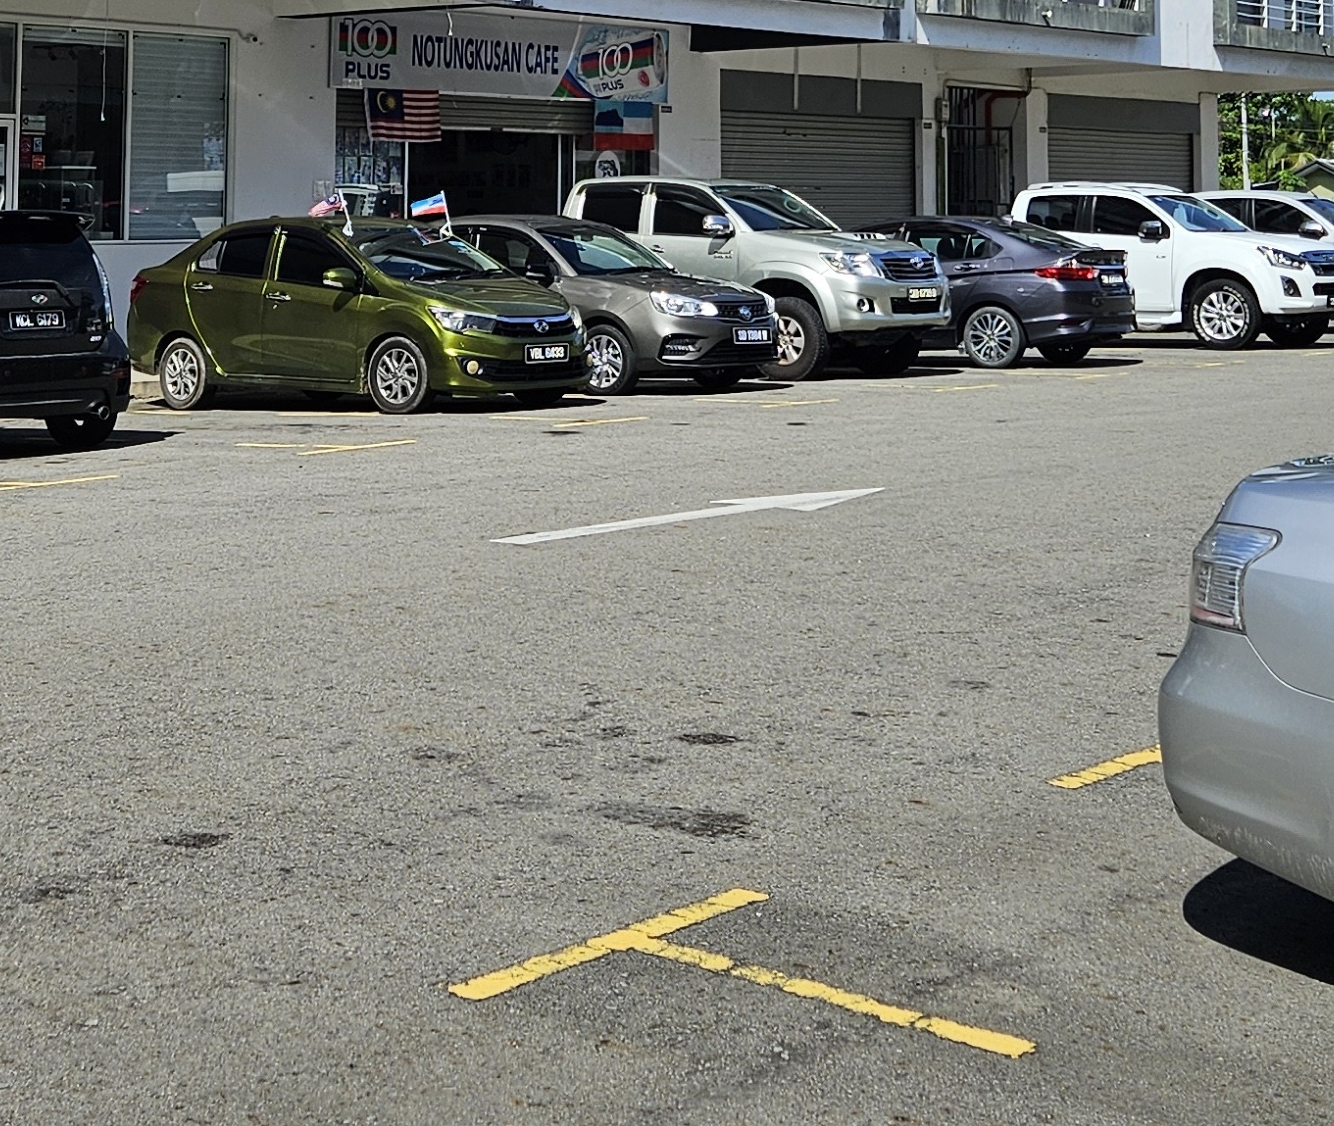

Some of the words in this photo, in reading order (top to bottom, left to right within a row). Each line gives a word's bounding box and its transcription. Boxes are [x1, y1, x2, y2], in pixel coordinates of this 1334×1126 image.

[343, 17, 393, 59] 100
[411, 34, 521, 74] NOTUNGKUSAN
[525, 44, 559, 75] CAFE
[598, 41, 634, 81] 100
[344, 60, 391, 81] PLUS
[601, 78, 624, 91] PLUS
[15, 314, 35, 328] KCL
[36, 313, 60, 327] 6179
